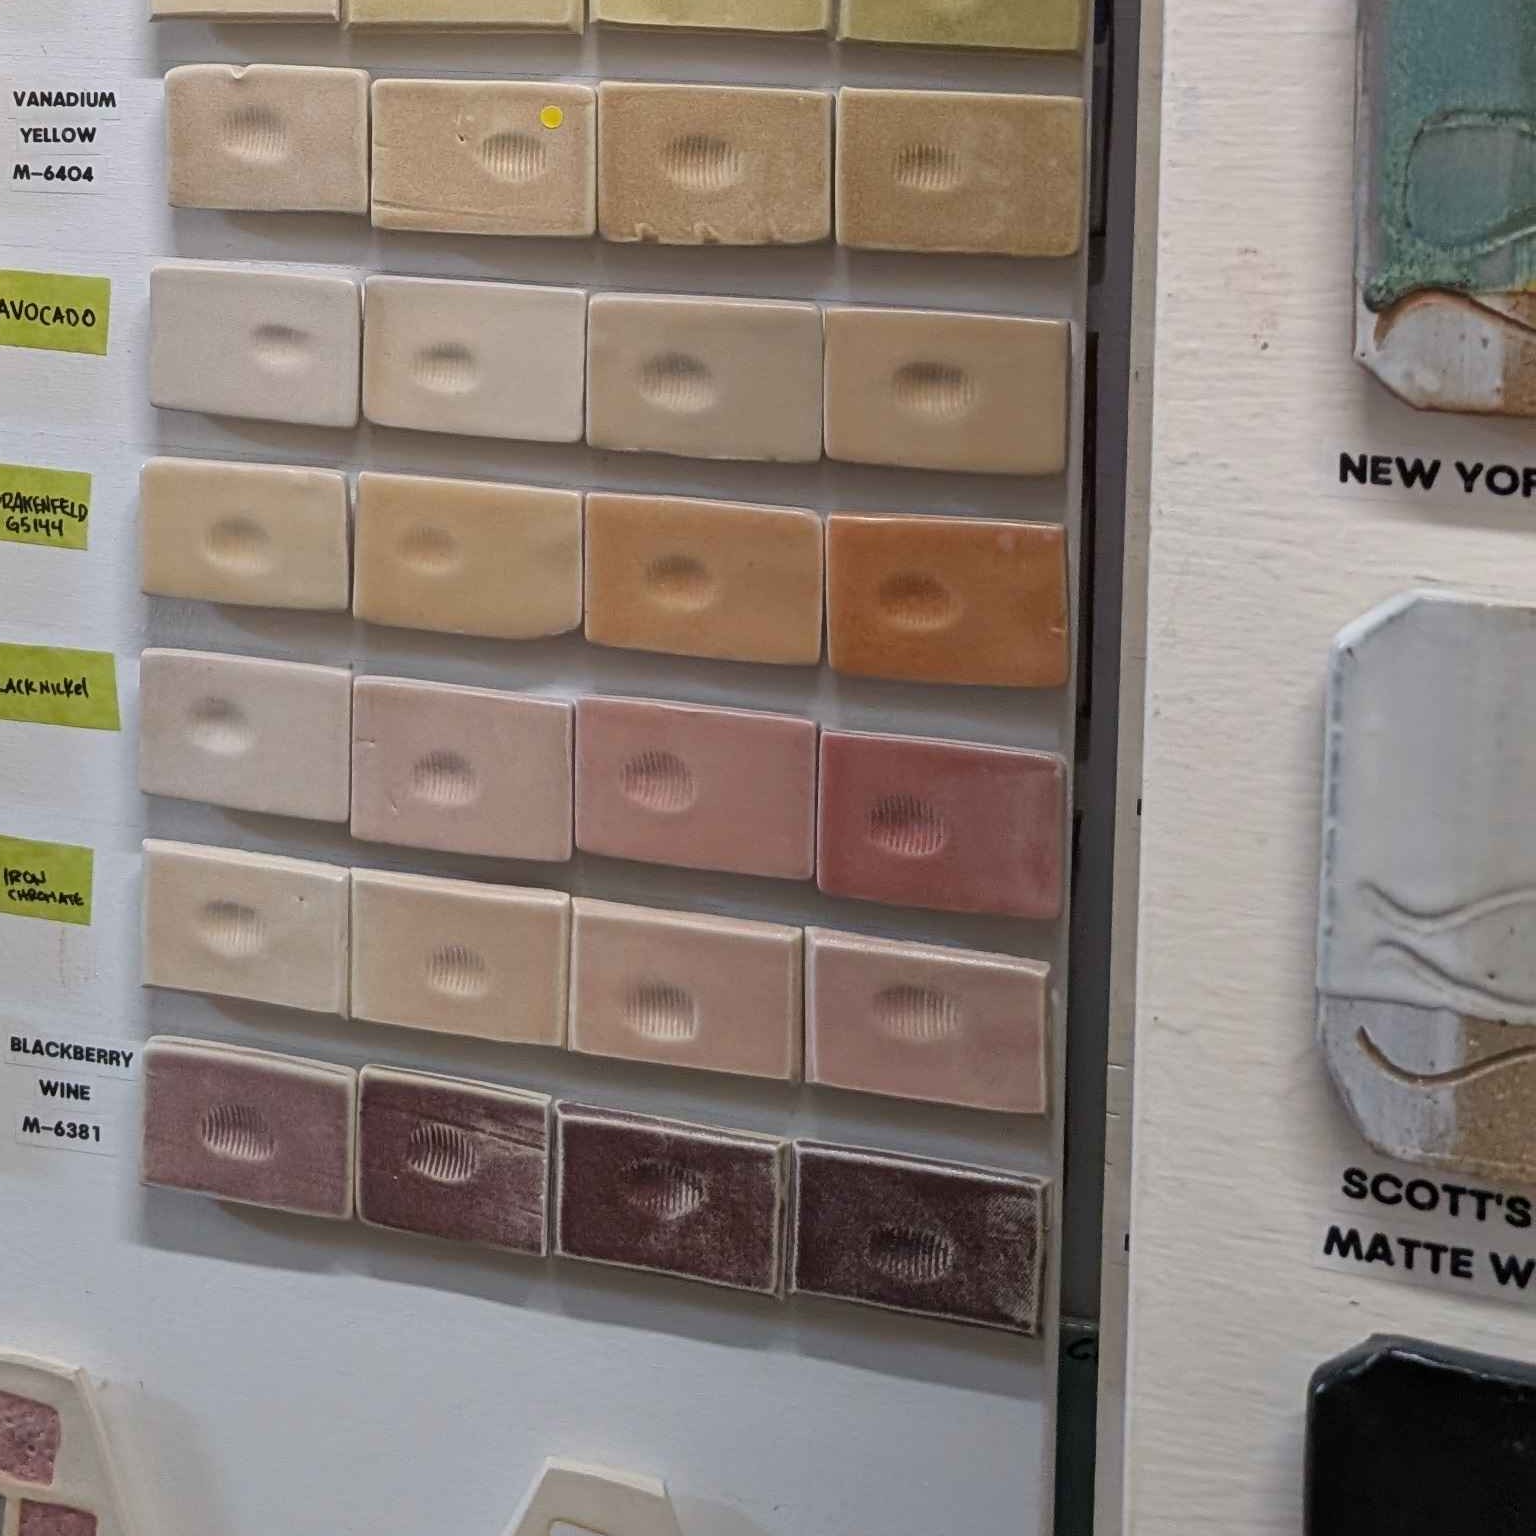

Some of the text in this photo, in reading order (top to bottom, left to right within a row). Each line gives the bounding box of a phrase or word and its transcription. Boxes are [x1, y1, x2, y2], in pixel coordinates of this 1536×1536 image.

[12, 90, 117, 109] VANADIUM
[19, 126, 97, 144] YELLOW
[1339, 452, 1441, 491] NEW
[3, 867, 46, 886] IRON
[10, 1035, 134, 1068] BLACKBERRY
[38, 1078, 91, 1101] WINE
[1341, 1166, 1532, 1229] SCOTT'S
[1323, 1224, 1475, 1280] MATTE
